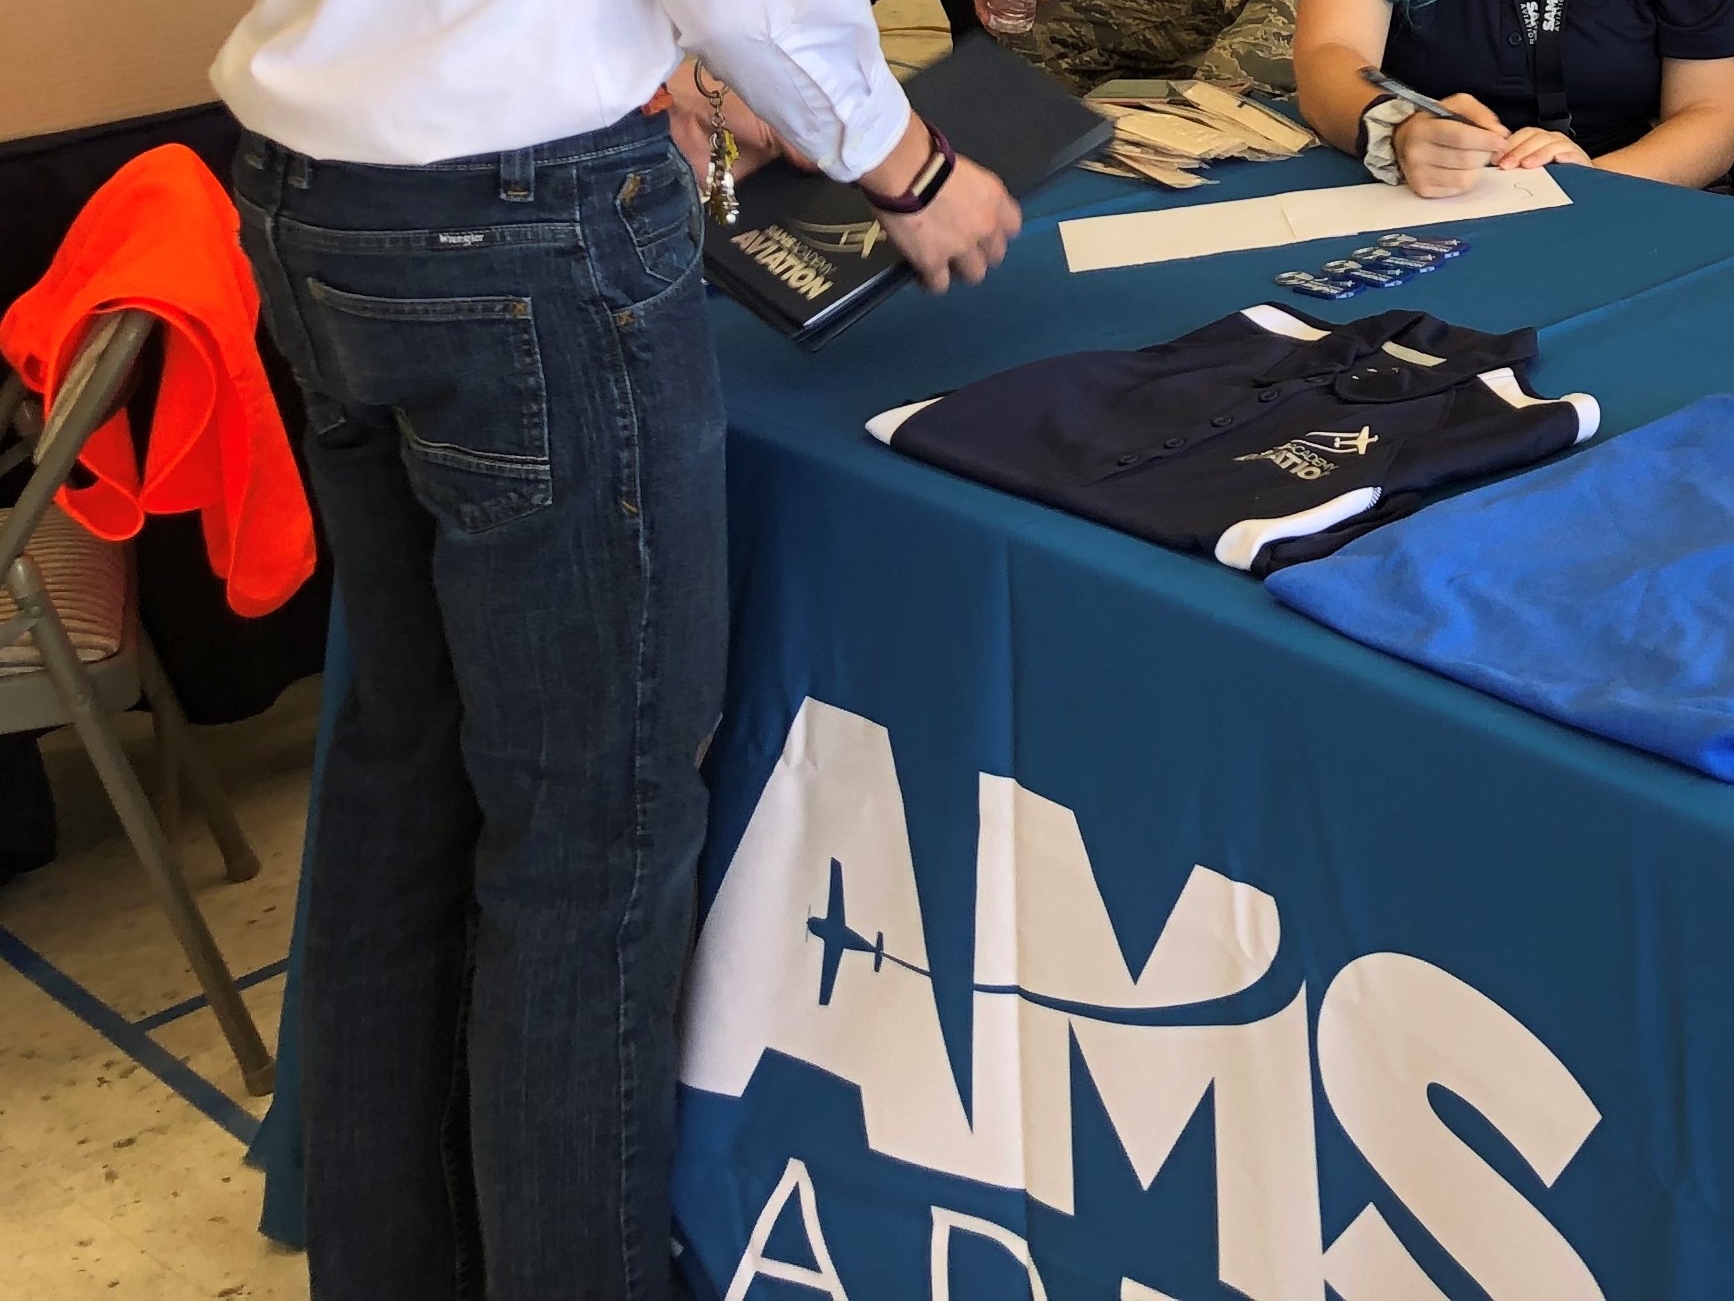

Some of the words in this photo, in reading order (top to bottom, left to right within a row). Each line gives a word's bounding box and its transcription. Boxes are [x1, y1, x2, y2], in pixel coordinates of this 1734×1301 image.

[1520, 3, 1535, 45] AVIATION
[729, 229, 834, 301] AVIATION
[678, 697, 1605, 1301] AMS
